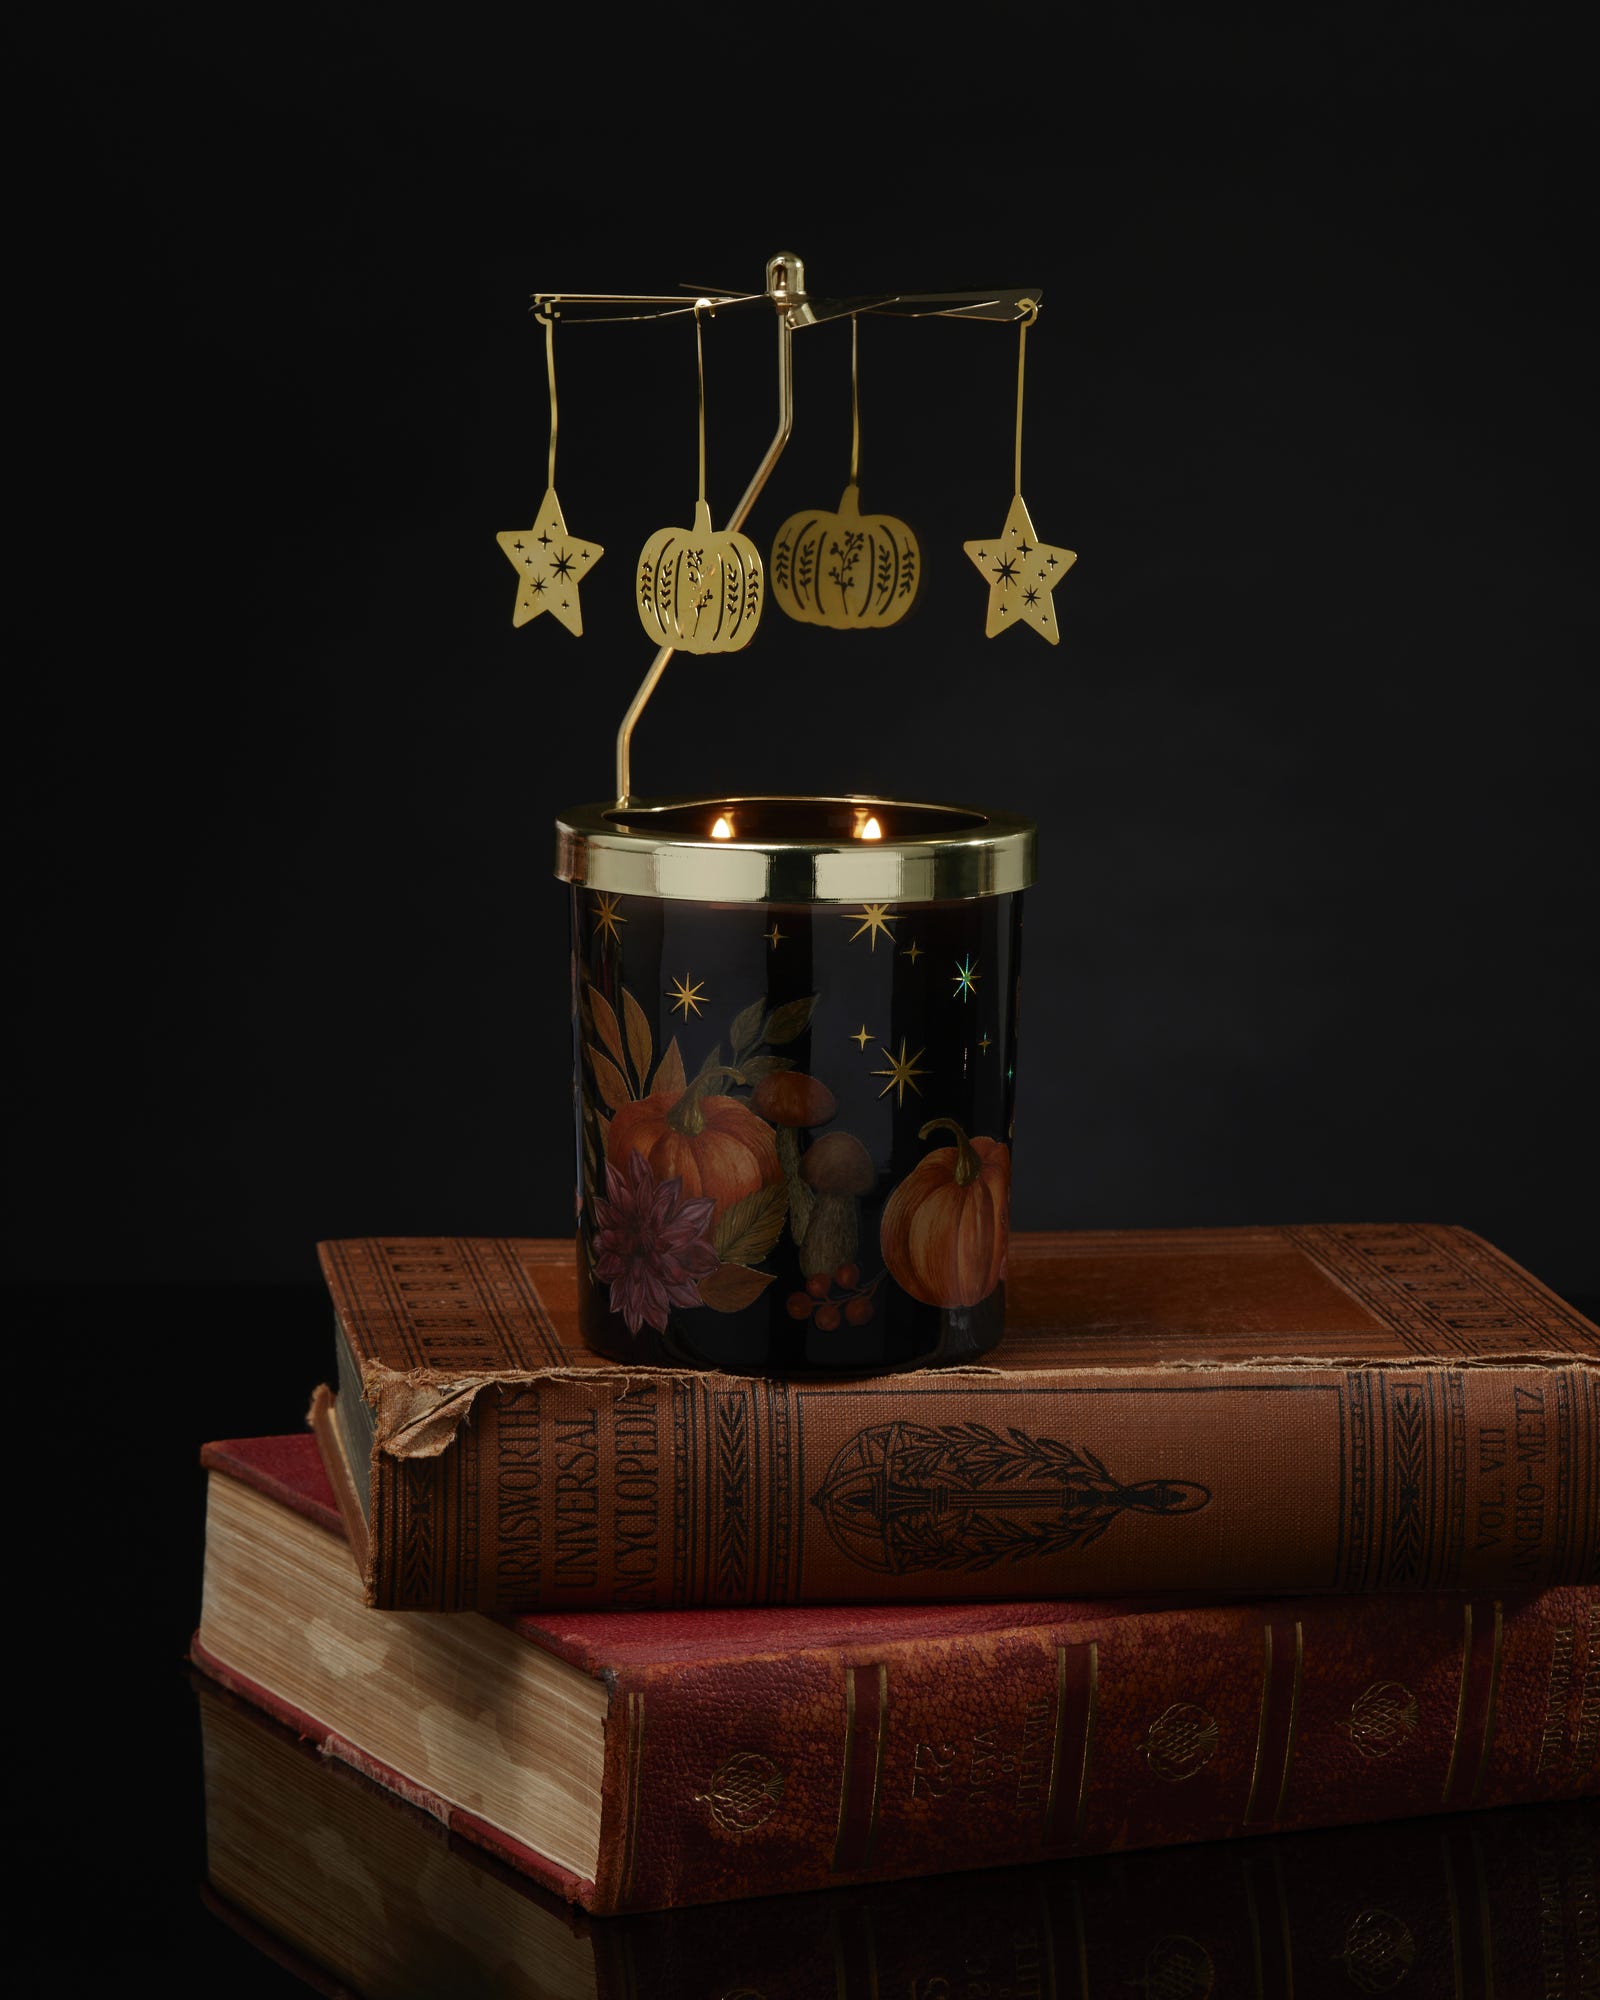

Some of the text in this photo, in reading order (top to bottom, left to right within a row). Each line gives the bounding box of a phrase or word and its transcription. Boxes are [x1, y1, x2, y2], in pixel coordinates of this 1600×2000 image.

[554, 1408, 599, 1588] UNIVERSAL
[614, 1384, 659, 1605] ENCYCLOPEDIA
[911, 1744, 956, 1802] 22
[1536, 1626, 1573, 1775] BRITANNICA
